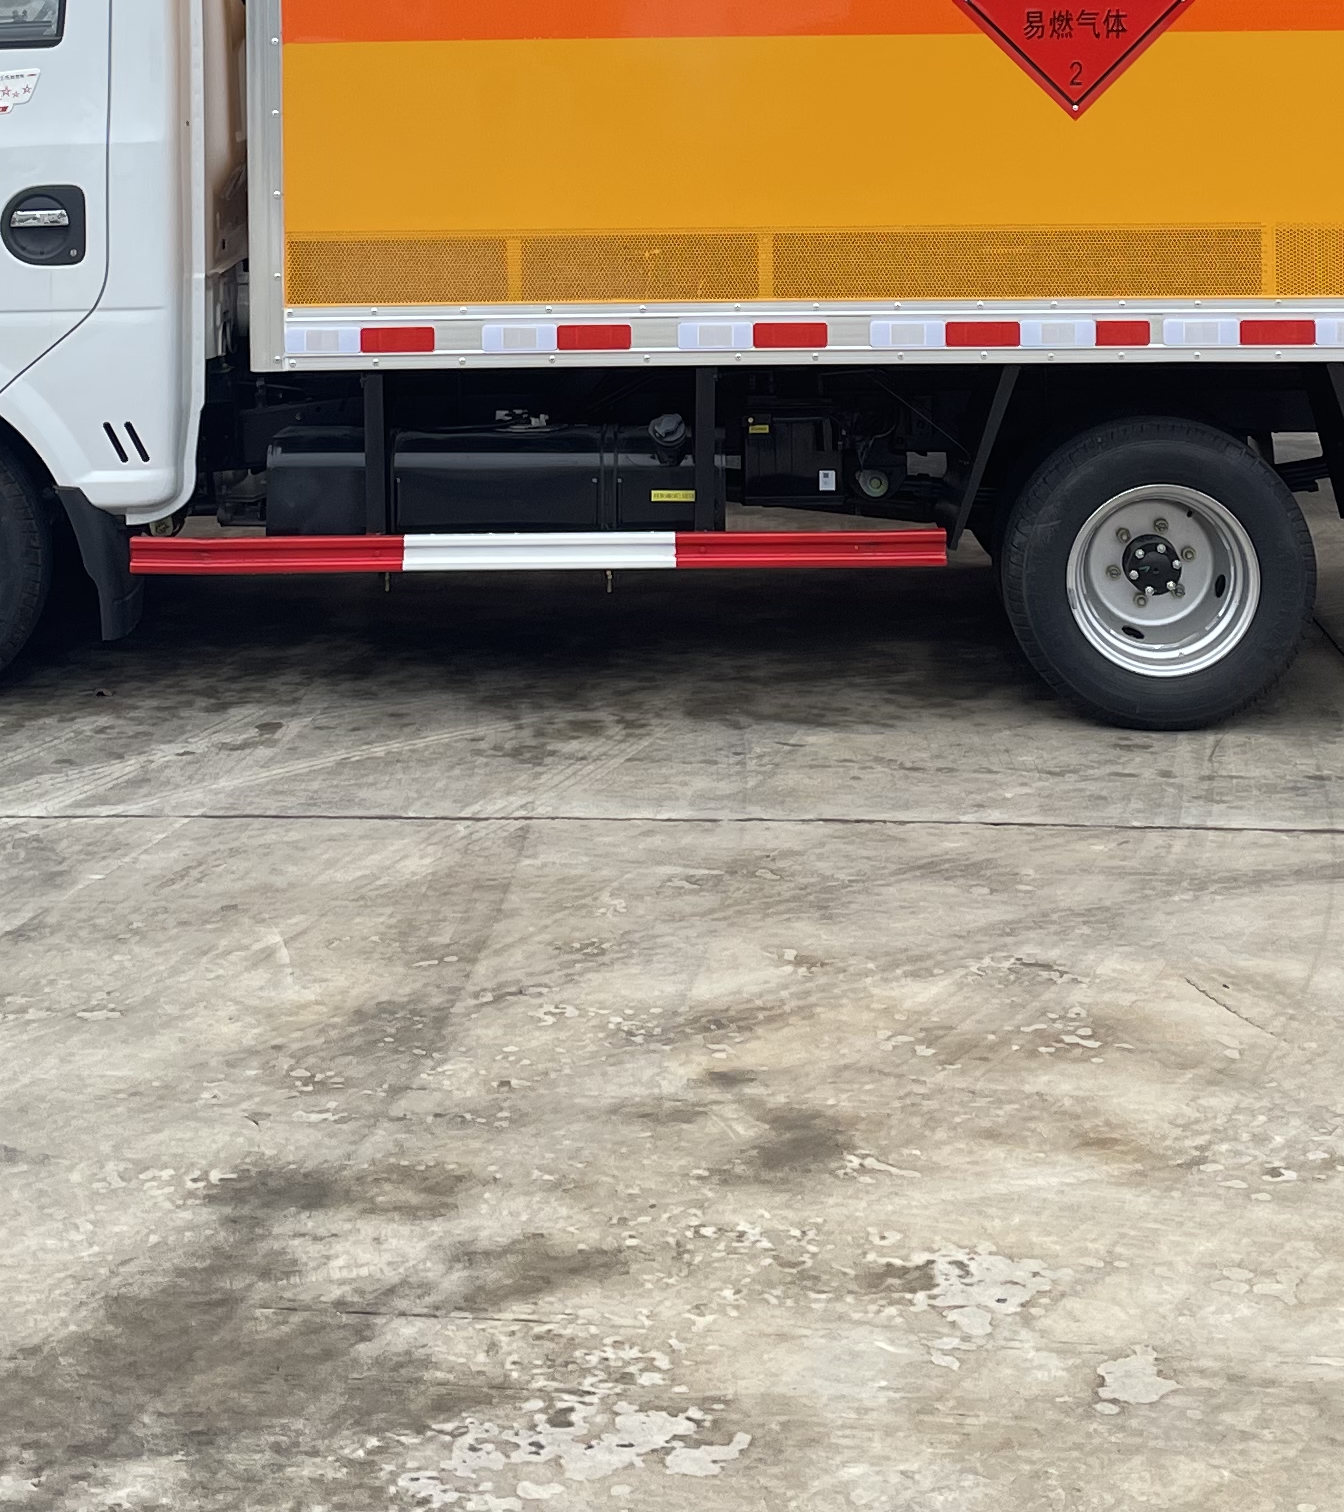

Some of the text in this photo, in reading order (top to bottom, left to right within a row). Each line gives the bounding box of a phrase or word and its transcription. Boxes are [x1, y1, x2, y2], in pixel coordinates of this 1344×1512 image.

[1023, 9, 1128, 40] 易燃气体
[1069, 61, 1083, 86] 2
